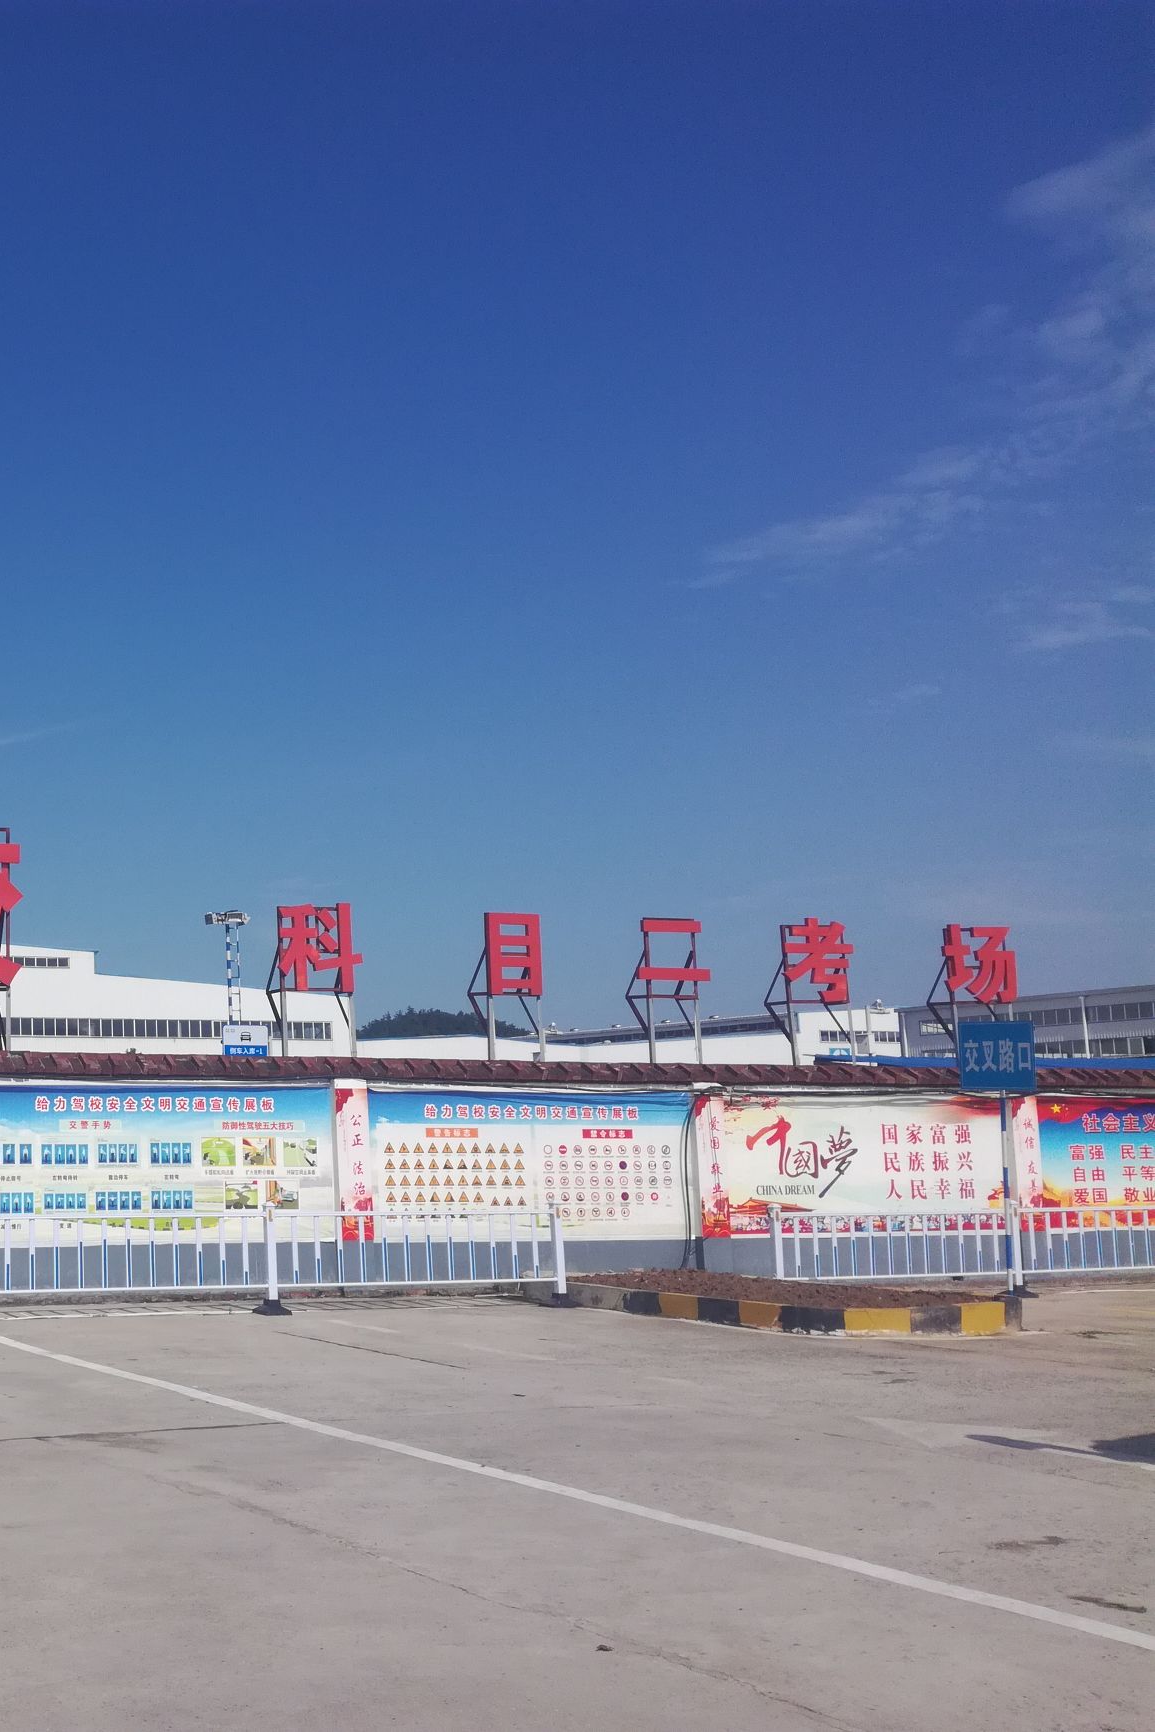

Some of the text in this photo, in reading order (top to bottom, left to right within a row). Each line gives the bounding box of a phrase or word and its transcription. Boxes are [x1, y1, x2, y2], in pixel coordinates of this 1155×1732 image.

[277, 903, 1017, 1004] 科目二考场
[963, 1038, 1032, 1073] 交叉路口
[35, 1096, 275, 1112] 给力驾校安全文明交通宣传展板
[424, 1104, 639, 1120] 给力驾校安全文明交通宣传展板
[69, 1119, 112, 1130] 交警手势
[221, 1121, 294, 1130] 防御性驾驶五大技巧
[434, 1129, 471, 1137] 警告标志
[590, 1129, 626, 1137] 禁令标志
[881, 1123, 972, 1145] 国家富强
[350, 1114, 365, 1195] 公正 法治
[1069, 1144, 1154, 1161] 富强 民主
[884, 1151, 974, 1173] 民族振兴
[1073, 1166, 1155, 1182] 自由 平等
[756, 1184, 815, 1196] CHINA DREAM
[886, 1178, 975, 1200] 人民幸福
[1074, 1187, 1155, 1204] 爱国 敬业
